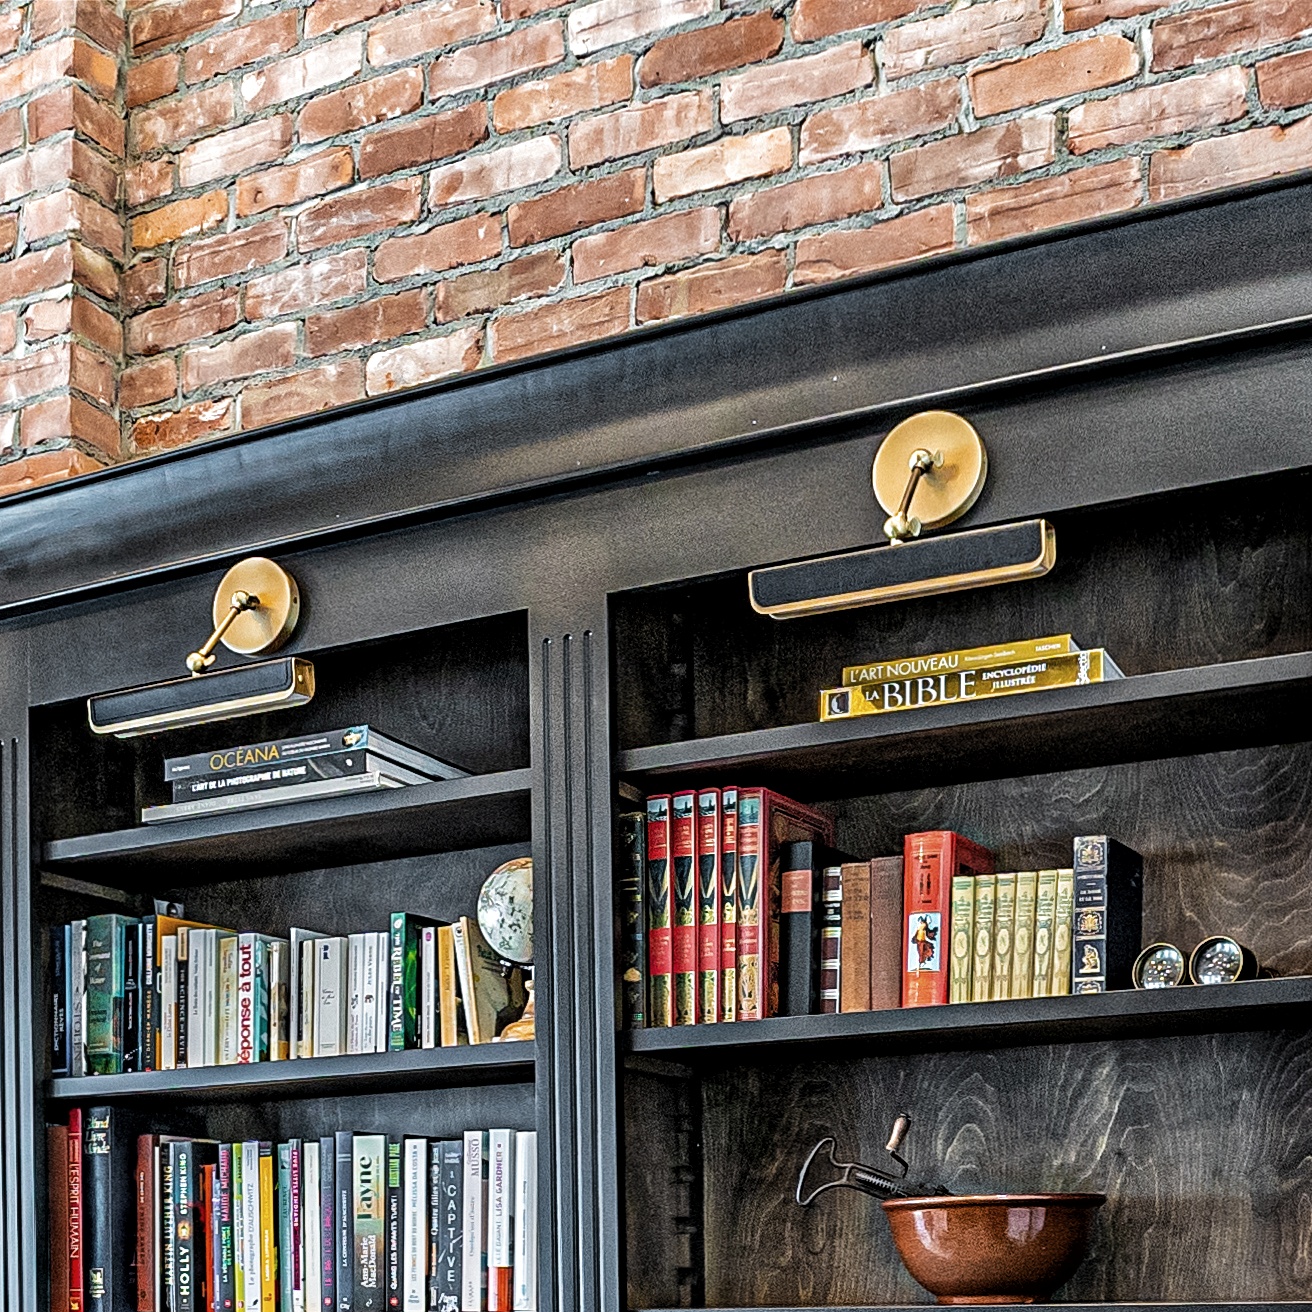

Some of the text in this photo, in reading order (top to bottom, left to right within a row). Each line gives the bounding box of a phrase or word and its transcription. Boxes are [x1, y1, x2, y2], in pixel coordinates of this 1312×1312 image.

[851, 655, 958, 682] L'ART NOUVEAU
[982, 663, 1047, 680] ENCYCLOPÉDIE
[866, 670, 977, 710] LA BIBLE
[209, 745, 280, 770] OCÉANA
[239, 944, 251, 978] tout
[392, 947, 403, 986] REBEL
[238, 982, 251, 992] à
[392, 995, 403, 1032] TIME
[412, 1171, 417, 1179] DA
[471, 1138, 479, 1176] MUSSO
[221, 1150, 229, 1221] MAUDE MICHAUD
[357, 1156, 376, 1219] Fayne
[70, 1164, 80, 1258] L'ESPRIT HUMAIN
[164, 1165, 173, 1285] MARTIN LUTHER KING
[179, 1246, 190, 1296] HOLLY
[360, 1237, 369, 1287] Ann-Marie
[368, 1234, 377, 1288] MacDonald
